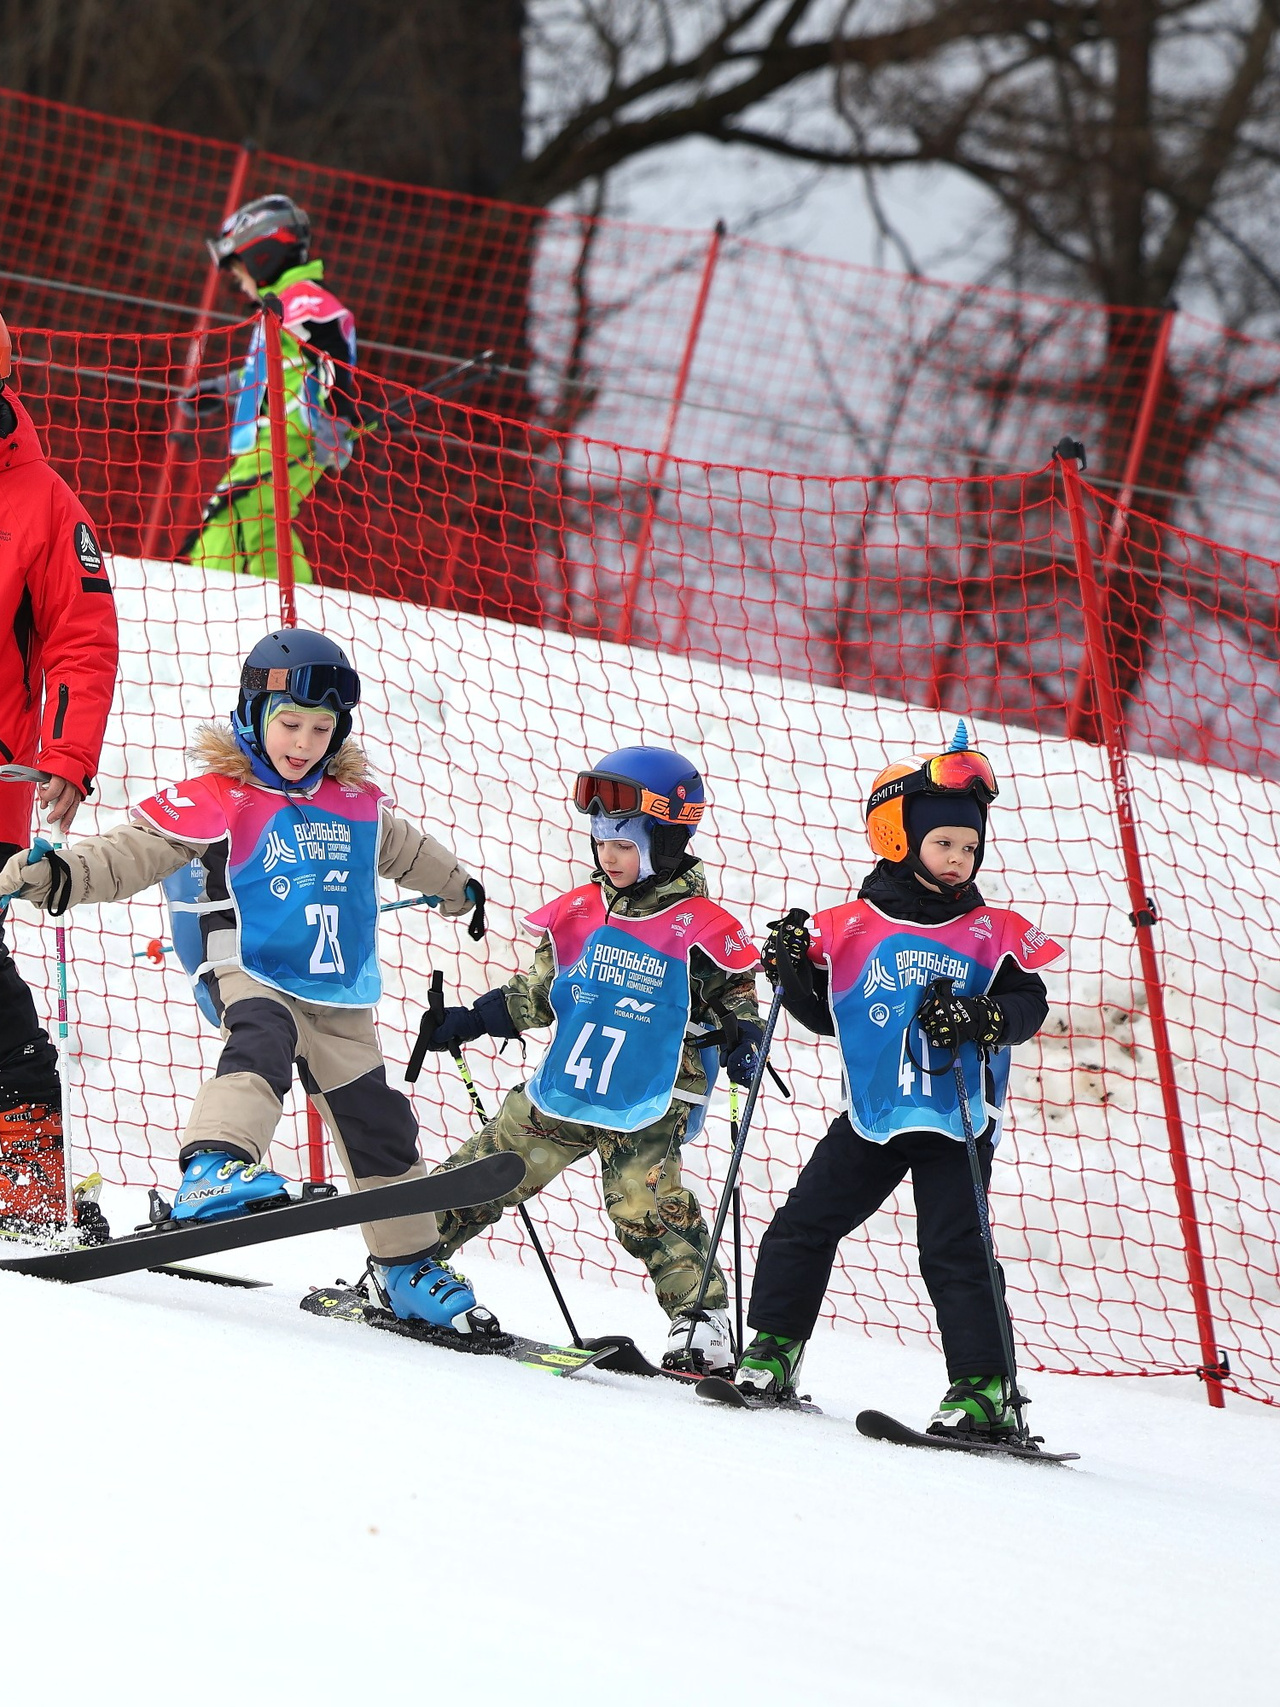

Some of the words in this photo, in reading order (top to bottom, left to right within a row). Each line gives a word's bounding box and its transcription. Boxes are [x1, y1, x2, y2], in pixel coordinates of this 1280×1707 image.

[871, 781, 904, 806] SMITH
[1113, 746, 1128, 819] LISKI
[162, 805, 180, 821] ЛИГА
[298, 841, 325, 861] ГОРЫ
[593, 944, 667, 978] ВОРОБЬЁВЫ
[895, 951, 969, 979] ВОРОБЬЁВЫ
[589, 962, 626, 986] ГОРЫ
[628, 972, 663, 988] СПОРТИВНЫЙ
[898, 967, 928, 989] ГОРЫ
[626, 981, 654, 994] КОМПЛЕКС
[614, 1009, 634, 1019] НОВАЯ
[634, 1013, 651, 1024] ЛИГА
[564, 1022, 627, 1095] 47
[178, 1183, 233, 1203] LANGE
